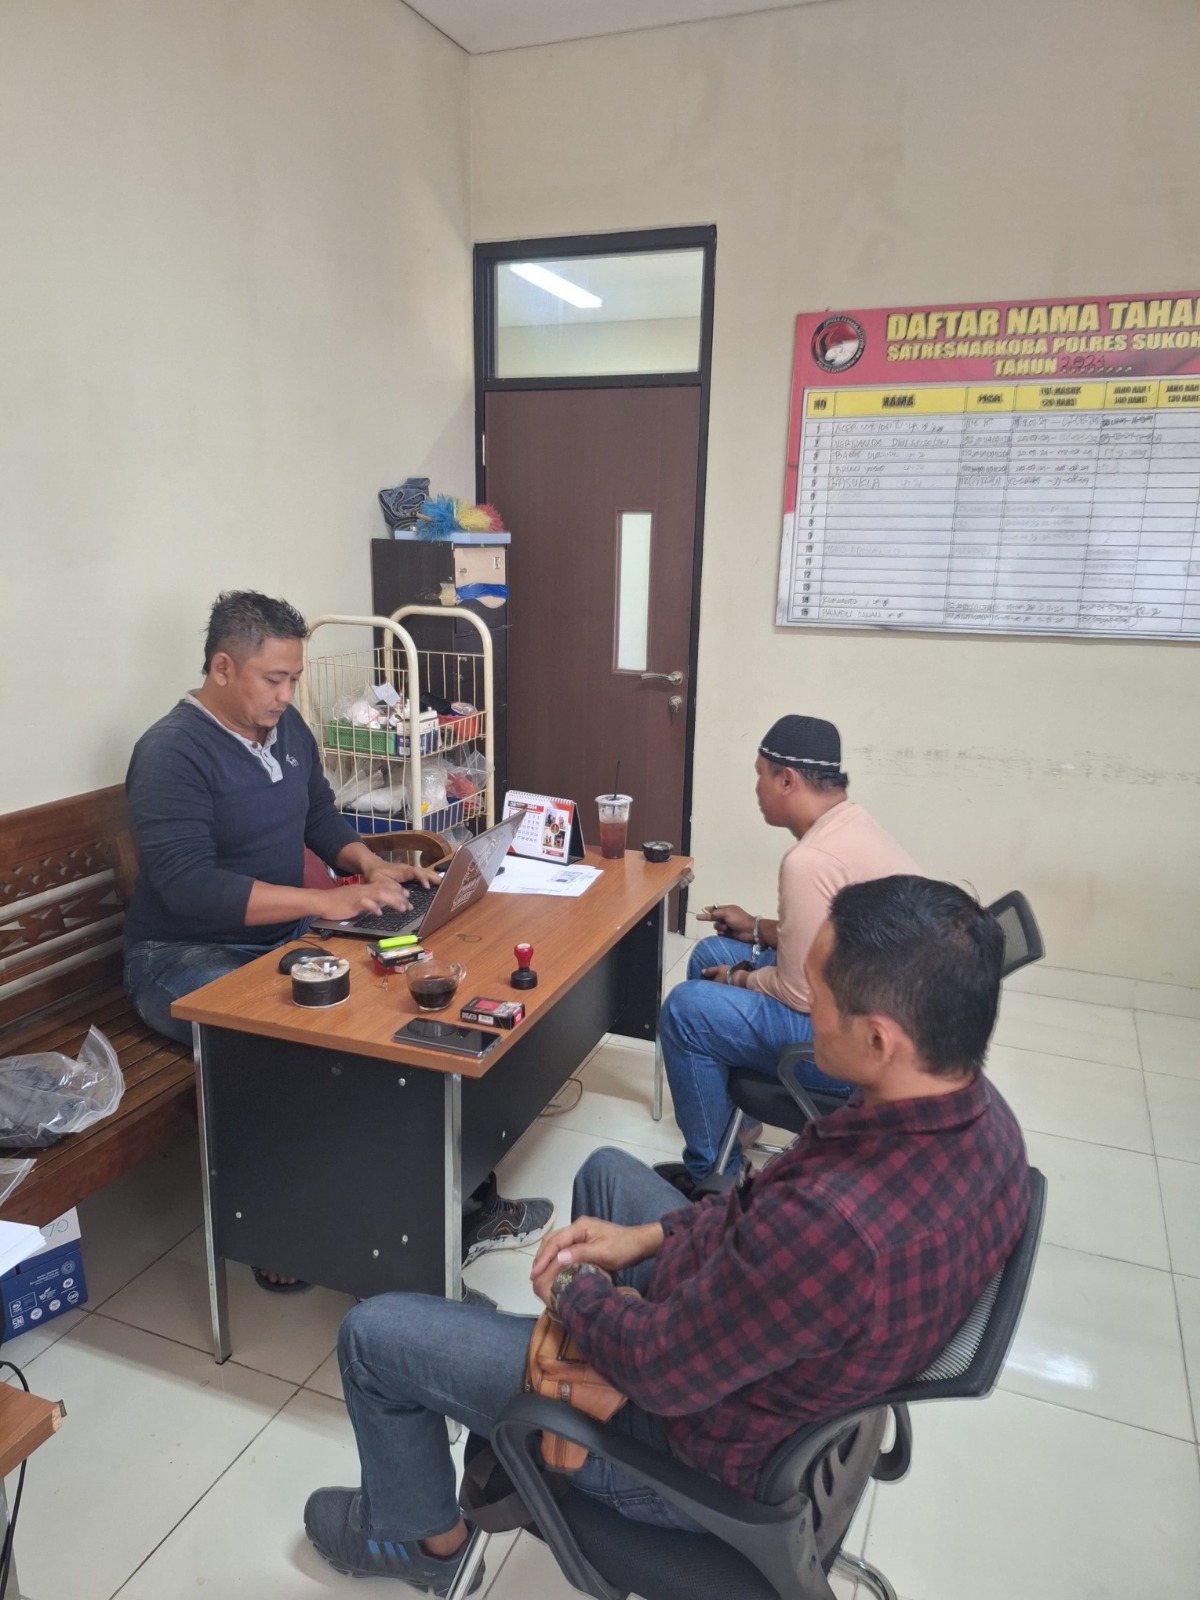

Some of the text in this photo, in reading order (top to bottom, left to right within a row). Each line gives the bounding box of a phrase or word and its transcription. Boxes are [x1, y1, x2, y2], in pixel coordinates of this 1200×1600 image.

[886, 308, 1000, 342] DAFTAR
[1005, 302, 1100, 337] NAMA
[886, 338, 1048, 361] SATRESNARKOBA
[1052, 333, 1128, 355] POLRES
[993, 357, 1058, 376] TAHUN
[813, 398, 827, 410] NO
[882, 394, 915, 409] NAMA
